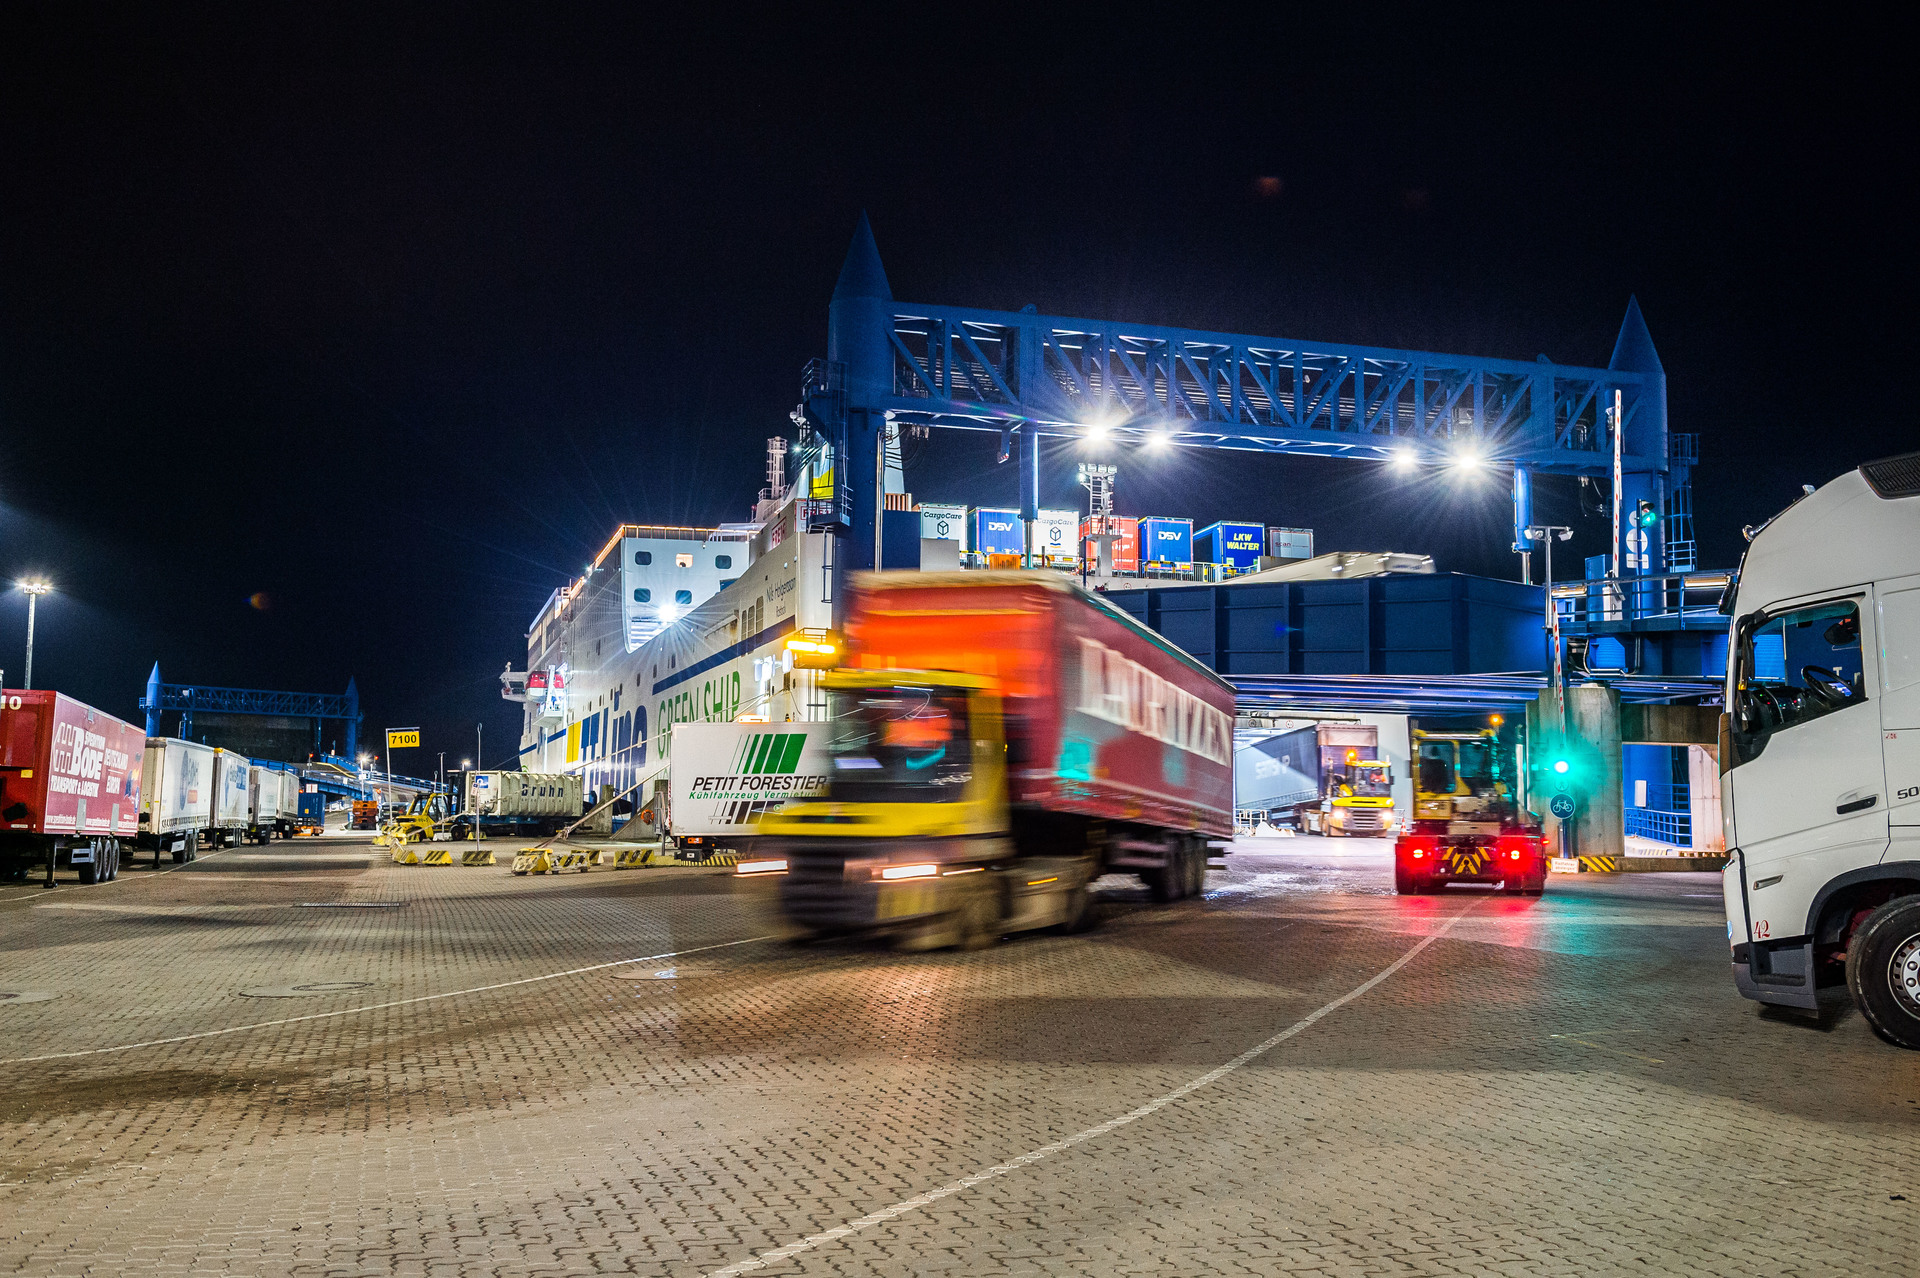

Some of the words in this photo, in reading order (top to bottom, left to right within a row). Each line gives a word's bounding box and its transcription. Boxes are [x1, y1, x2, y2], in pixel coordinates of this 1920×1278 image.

[923, 512, 962, 520] CargoCare
[988, 522, 1013, 532] DSV
[1158, 531, 1182, 541] DSV
[1233, 533, 1253, 542] LKW
[1226, 541, 1260, 551] WALTER
[704, 671, 740, 722] SHIP
[391, 734, 417, 744] 7100
[67, 726, 104, 780] BODE
[692, 776, 739, 791] PETIT
[739, 776, 827, 791] FORESTIER
[521, 783, 564, 798] Bruhn
[689, 791, 759, 800] Kühlfahrzeug
[764, 790, 824, 799] Vermietun
[1897, 786, 1920, 800] 50
[1753, 919, 1771, 939] 42
